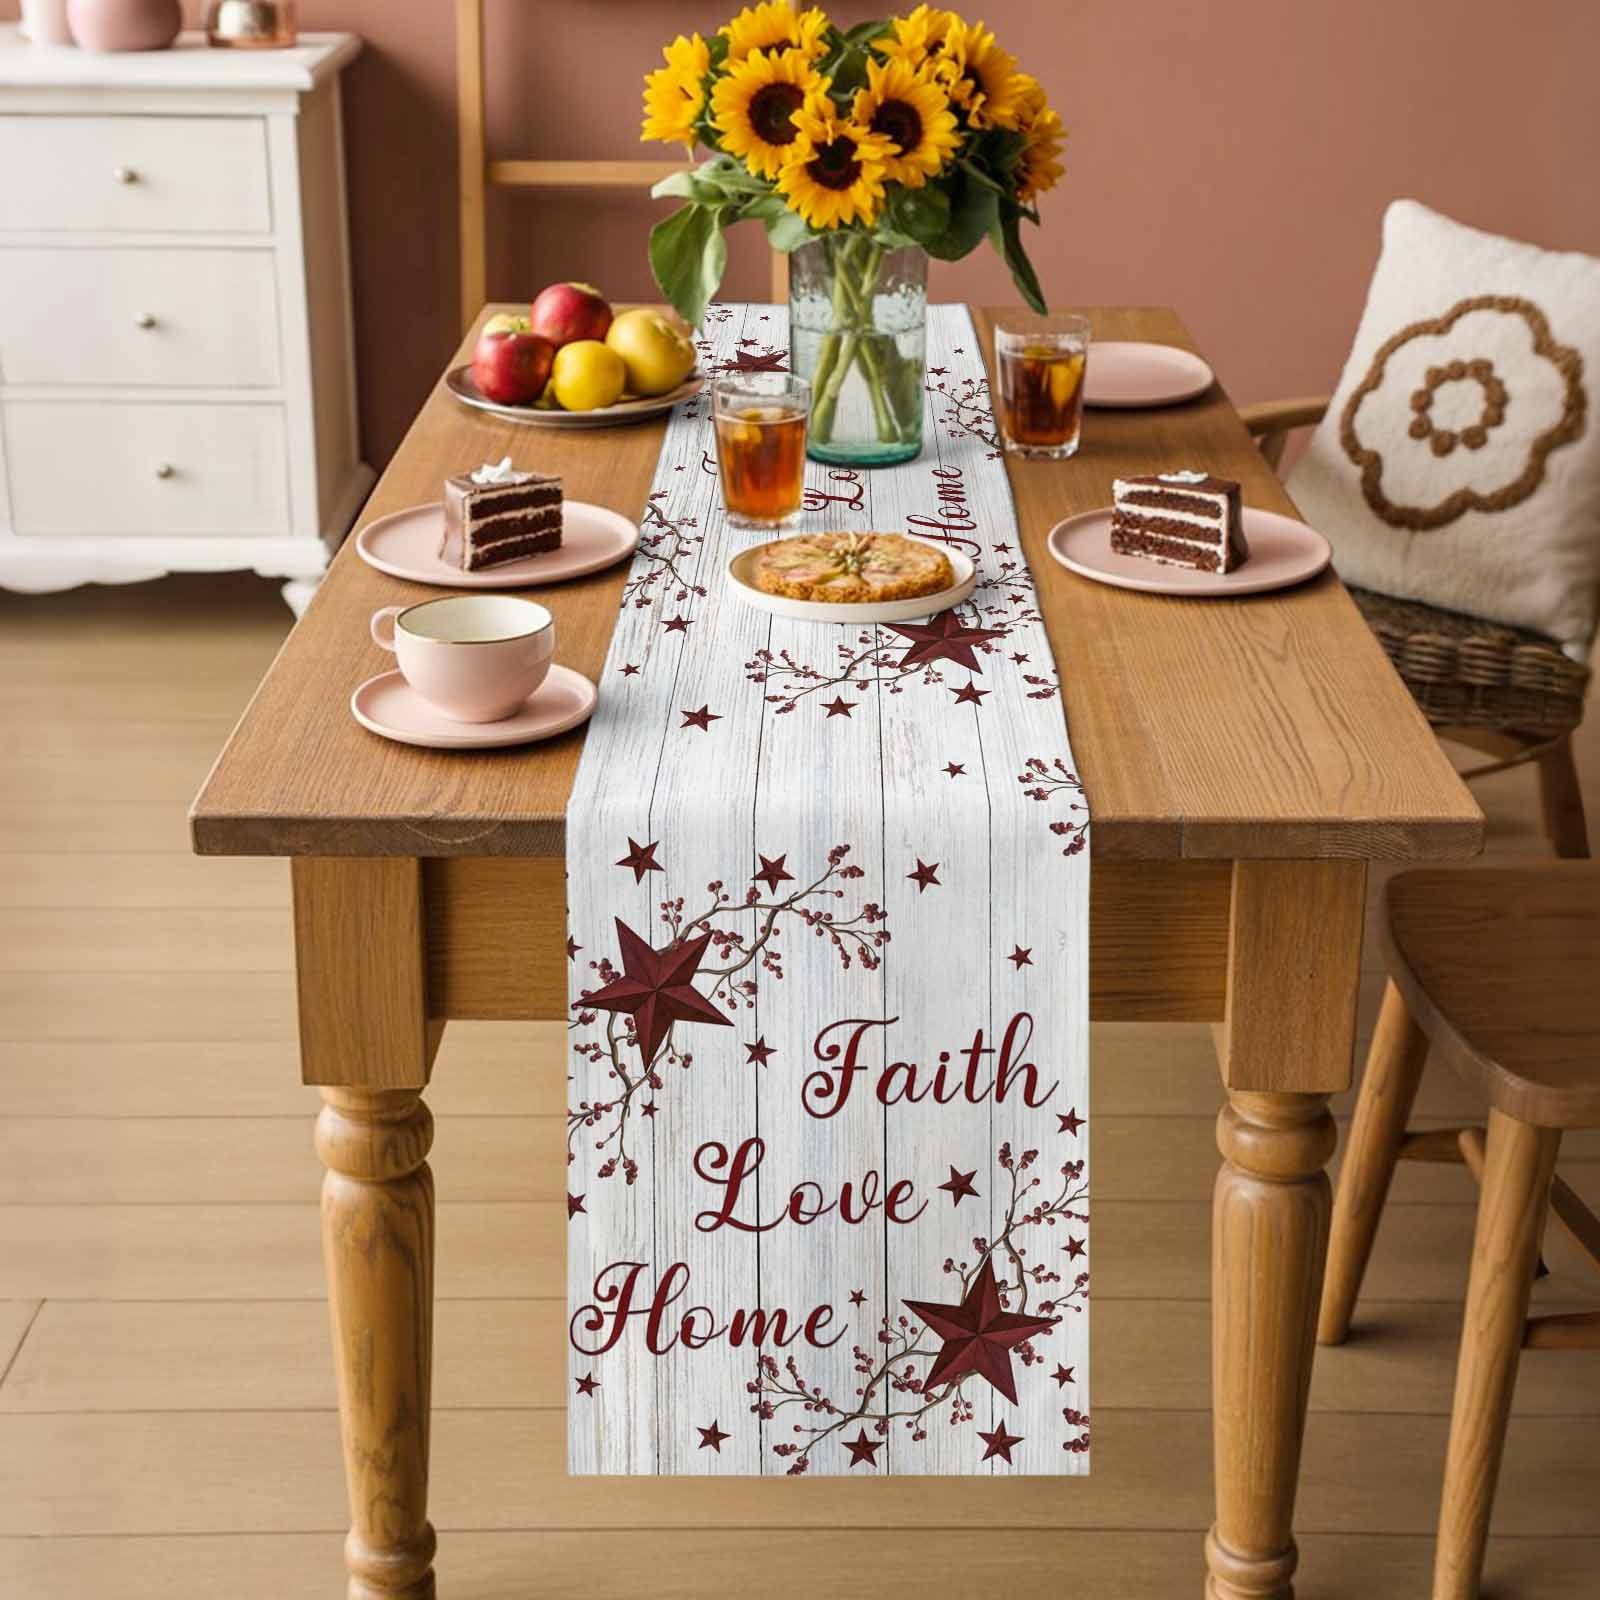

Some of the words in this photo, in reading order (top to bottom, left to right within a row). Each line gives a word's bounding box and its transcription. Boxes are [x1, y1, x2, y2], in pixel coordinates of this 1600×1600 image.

[803, 469, 864, 511] Lo
[906, 464, 982, 558] Home
[801, 1012, 1058, 1119] Faith
[694, 1137, 928, 1232] Love
[570, 1262, 848, 1355] Home
